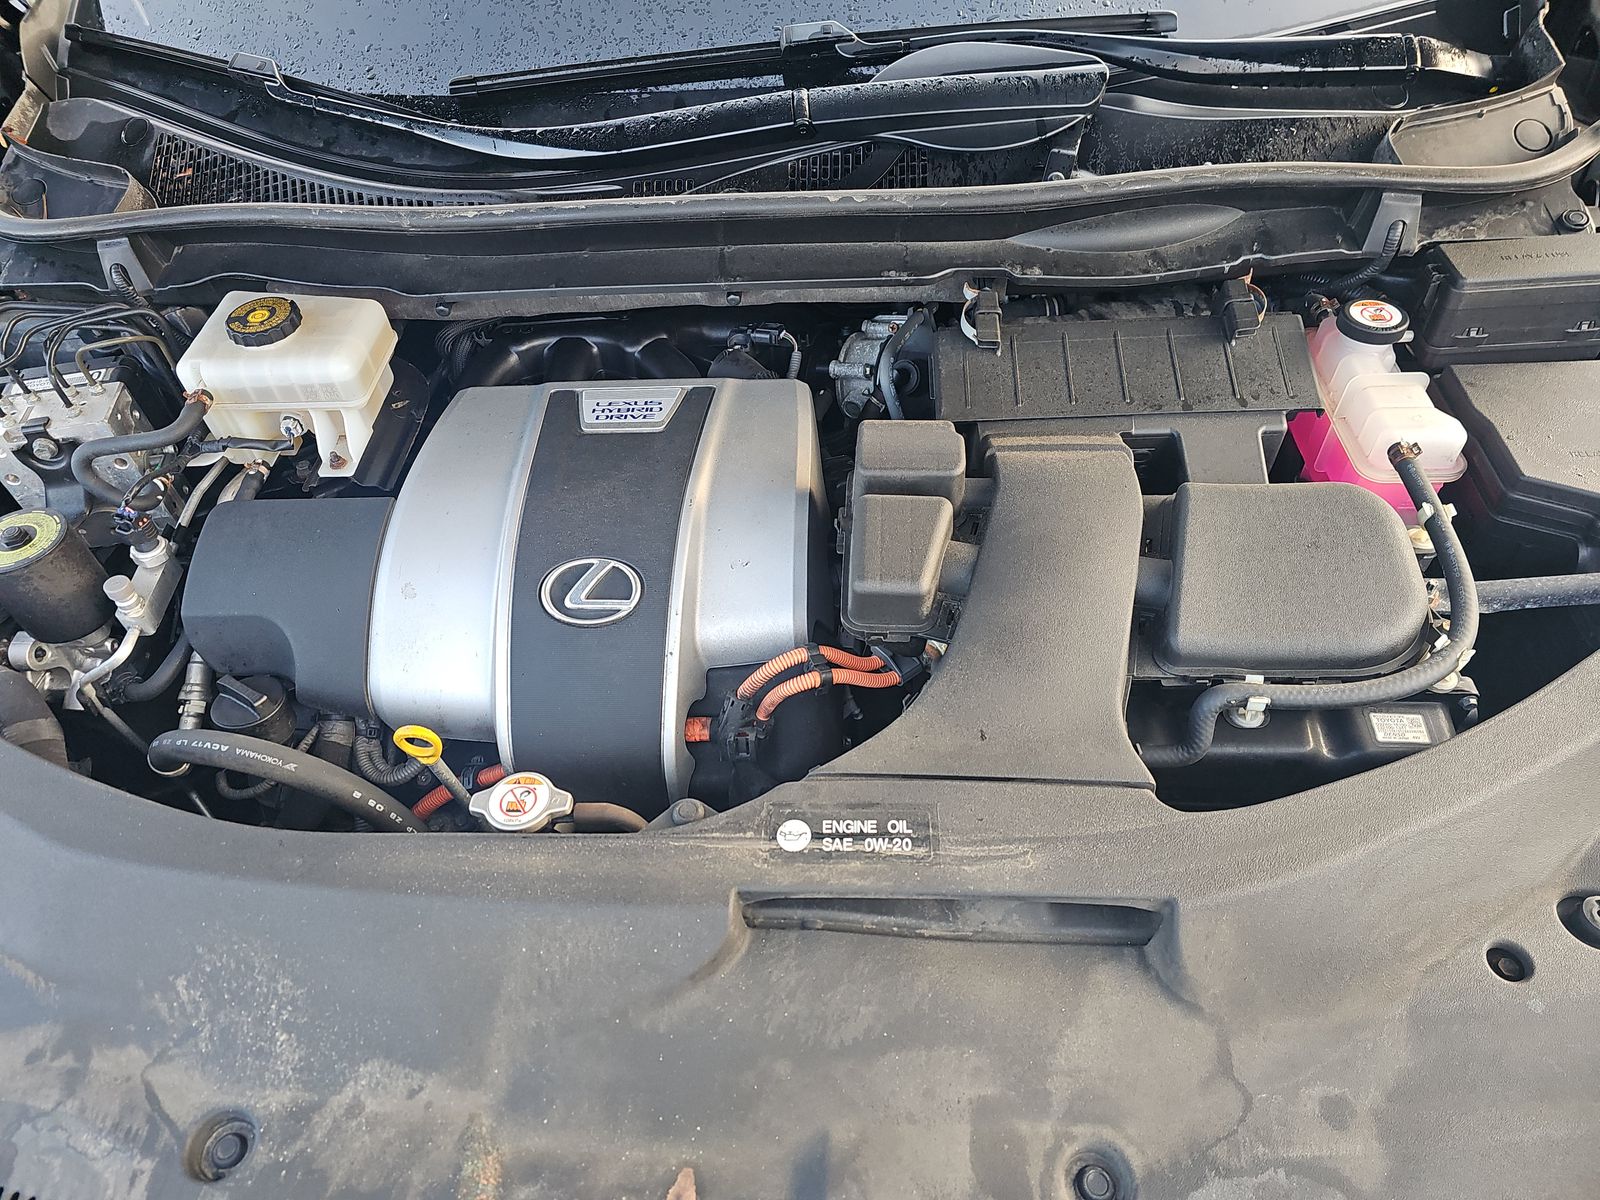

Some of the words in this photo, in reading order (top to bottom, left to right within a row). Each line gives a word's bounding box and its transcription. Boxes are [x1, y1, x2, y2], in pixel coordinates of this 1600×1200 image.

[591, 406, 663, 414] HYBRID
[595, 413, 657, 421] DRIVE
[191, 740, 230, 752] ACV17
[235, 747, 283, 767] YOKOHAMA
[822, 819, 878, 834] ENGINE
[886, 819, 914, 834] OIL
[822, 837, 853, 852] SAE
[864, 837, 913, 852] 0W-20
